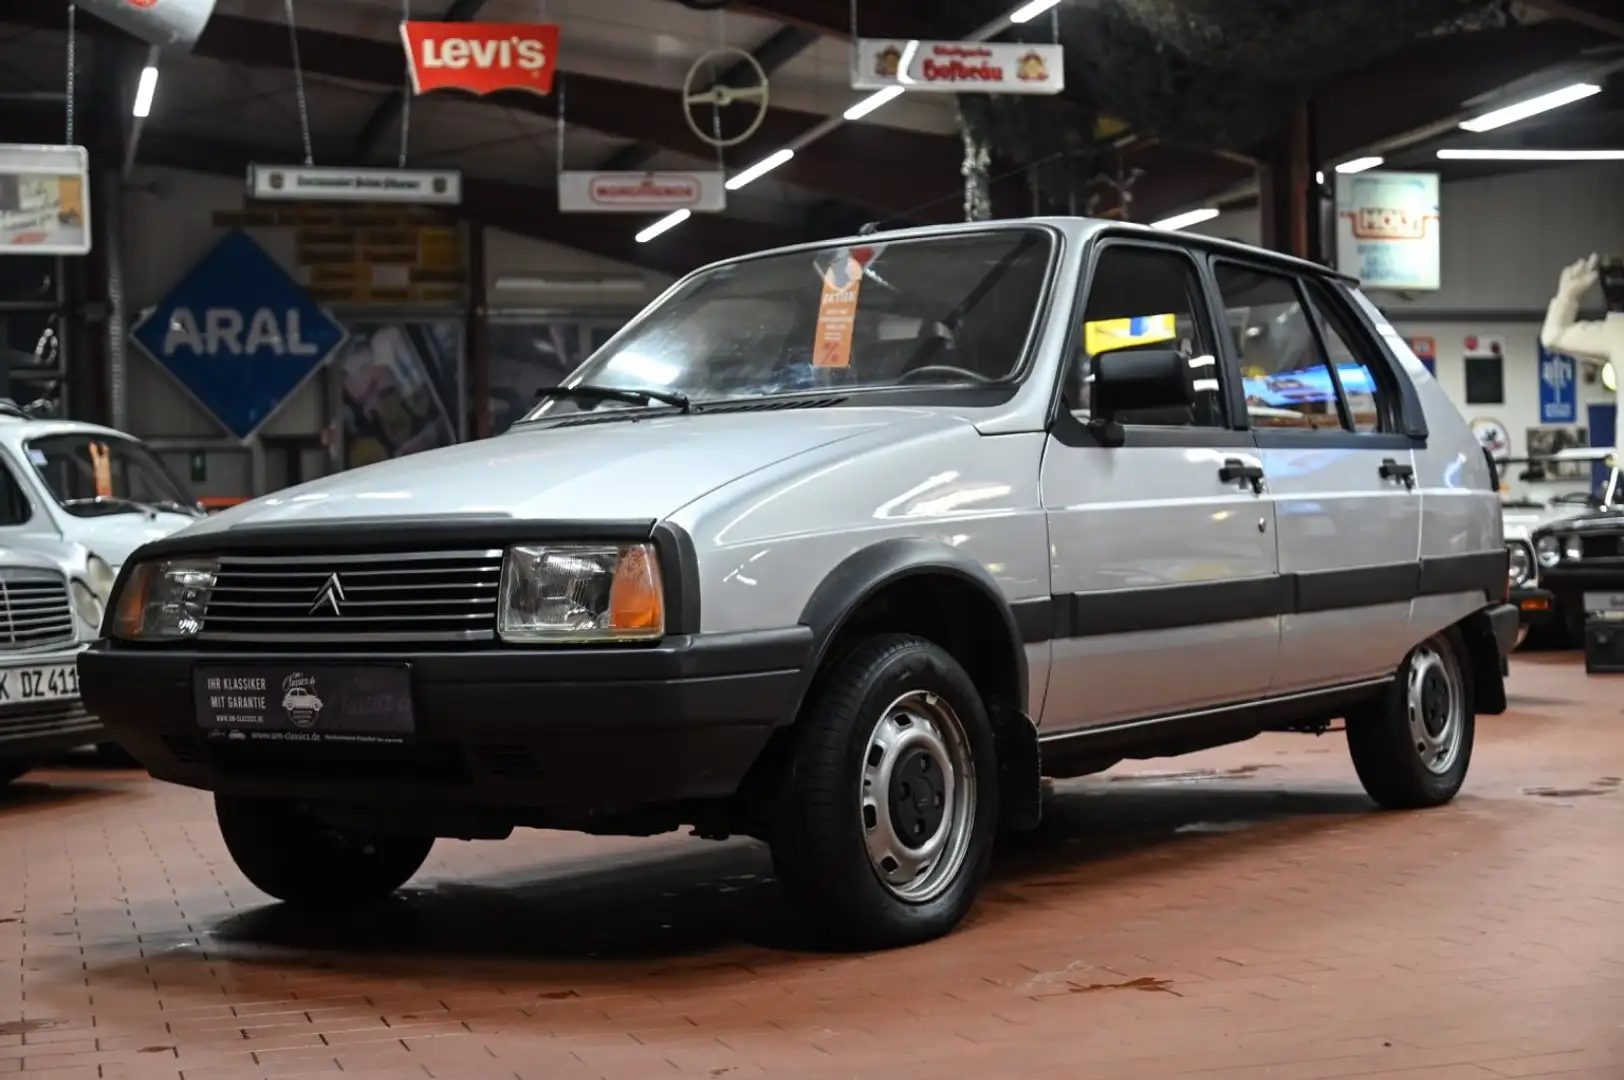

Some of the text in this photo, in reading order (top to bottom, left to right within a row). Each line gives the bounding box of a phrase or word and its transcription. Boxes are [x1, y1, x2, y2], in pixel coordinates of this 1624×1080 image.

[163, 307, 318, 356] ARAL
[20, 670, 46, 698] DZ
[48, 667, 79, 695] 411
[207, 678, 266, 691] IHR KLASSIKER
[210, 696, 267, 709] MIT GARANTIE
